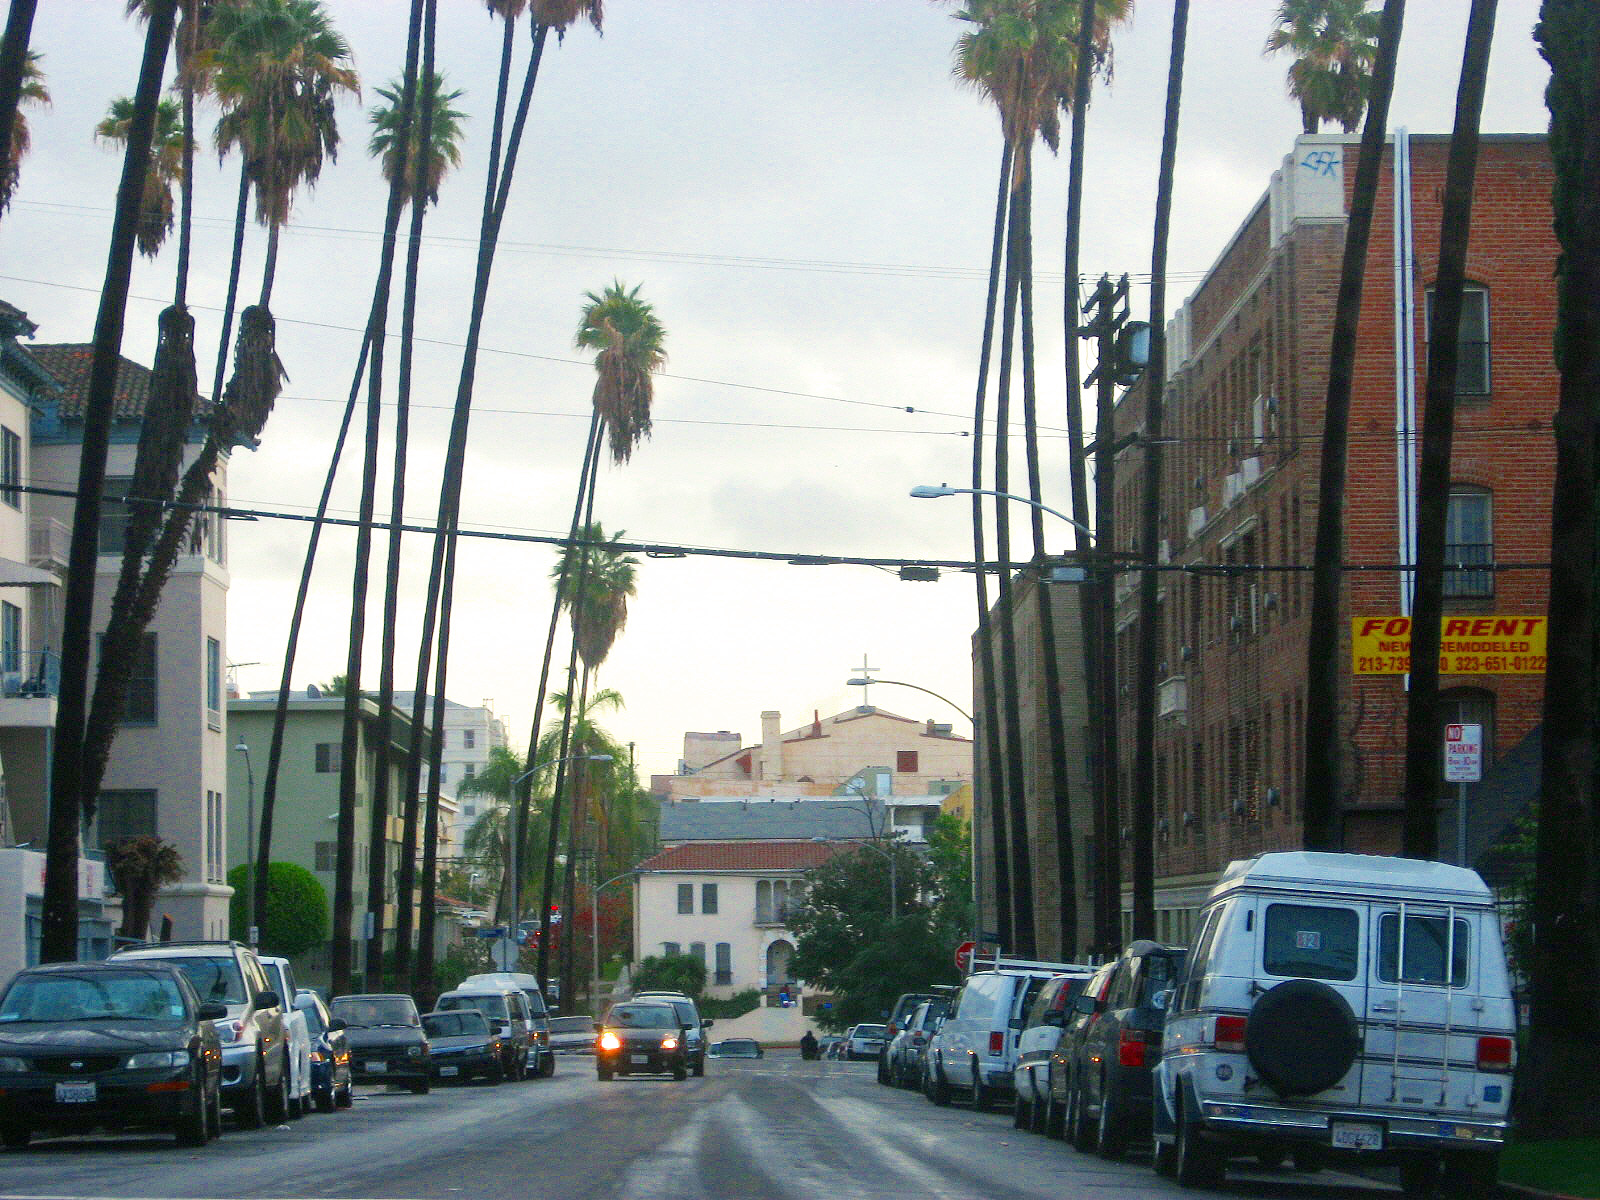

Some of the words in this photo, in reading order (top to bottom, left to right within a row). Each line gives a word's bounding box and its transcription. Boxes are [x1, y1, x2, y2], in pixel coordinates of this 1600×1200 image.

[1360, 619, 1411, 636] FO
[1445, 619, 1542, 636] RENT
[1439, 642, 1528, 652] REMODELED
[1456, 656, 1546, 670] 323-651-0122
[1448, 744, 1479, 754] PARKING
